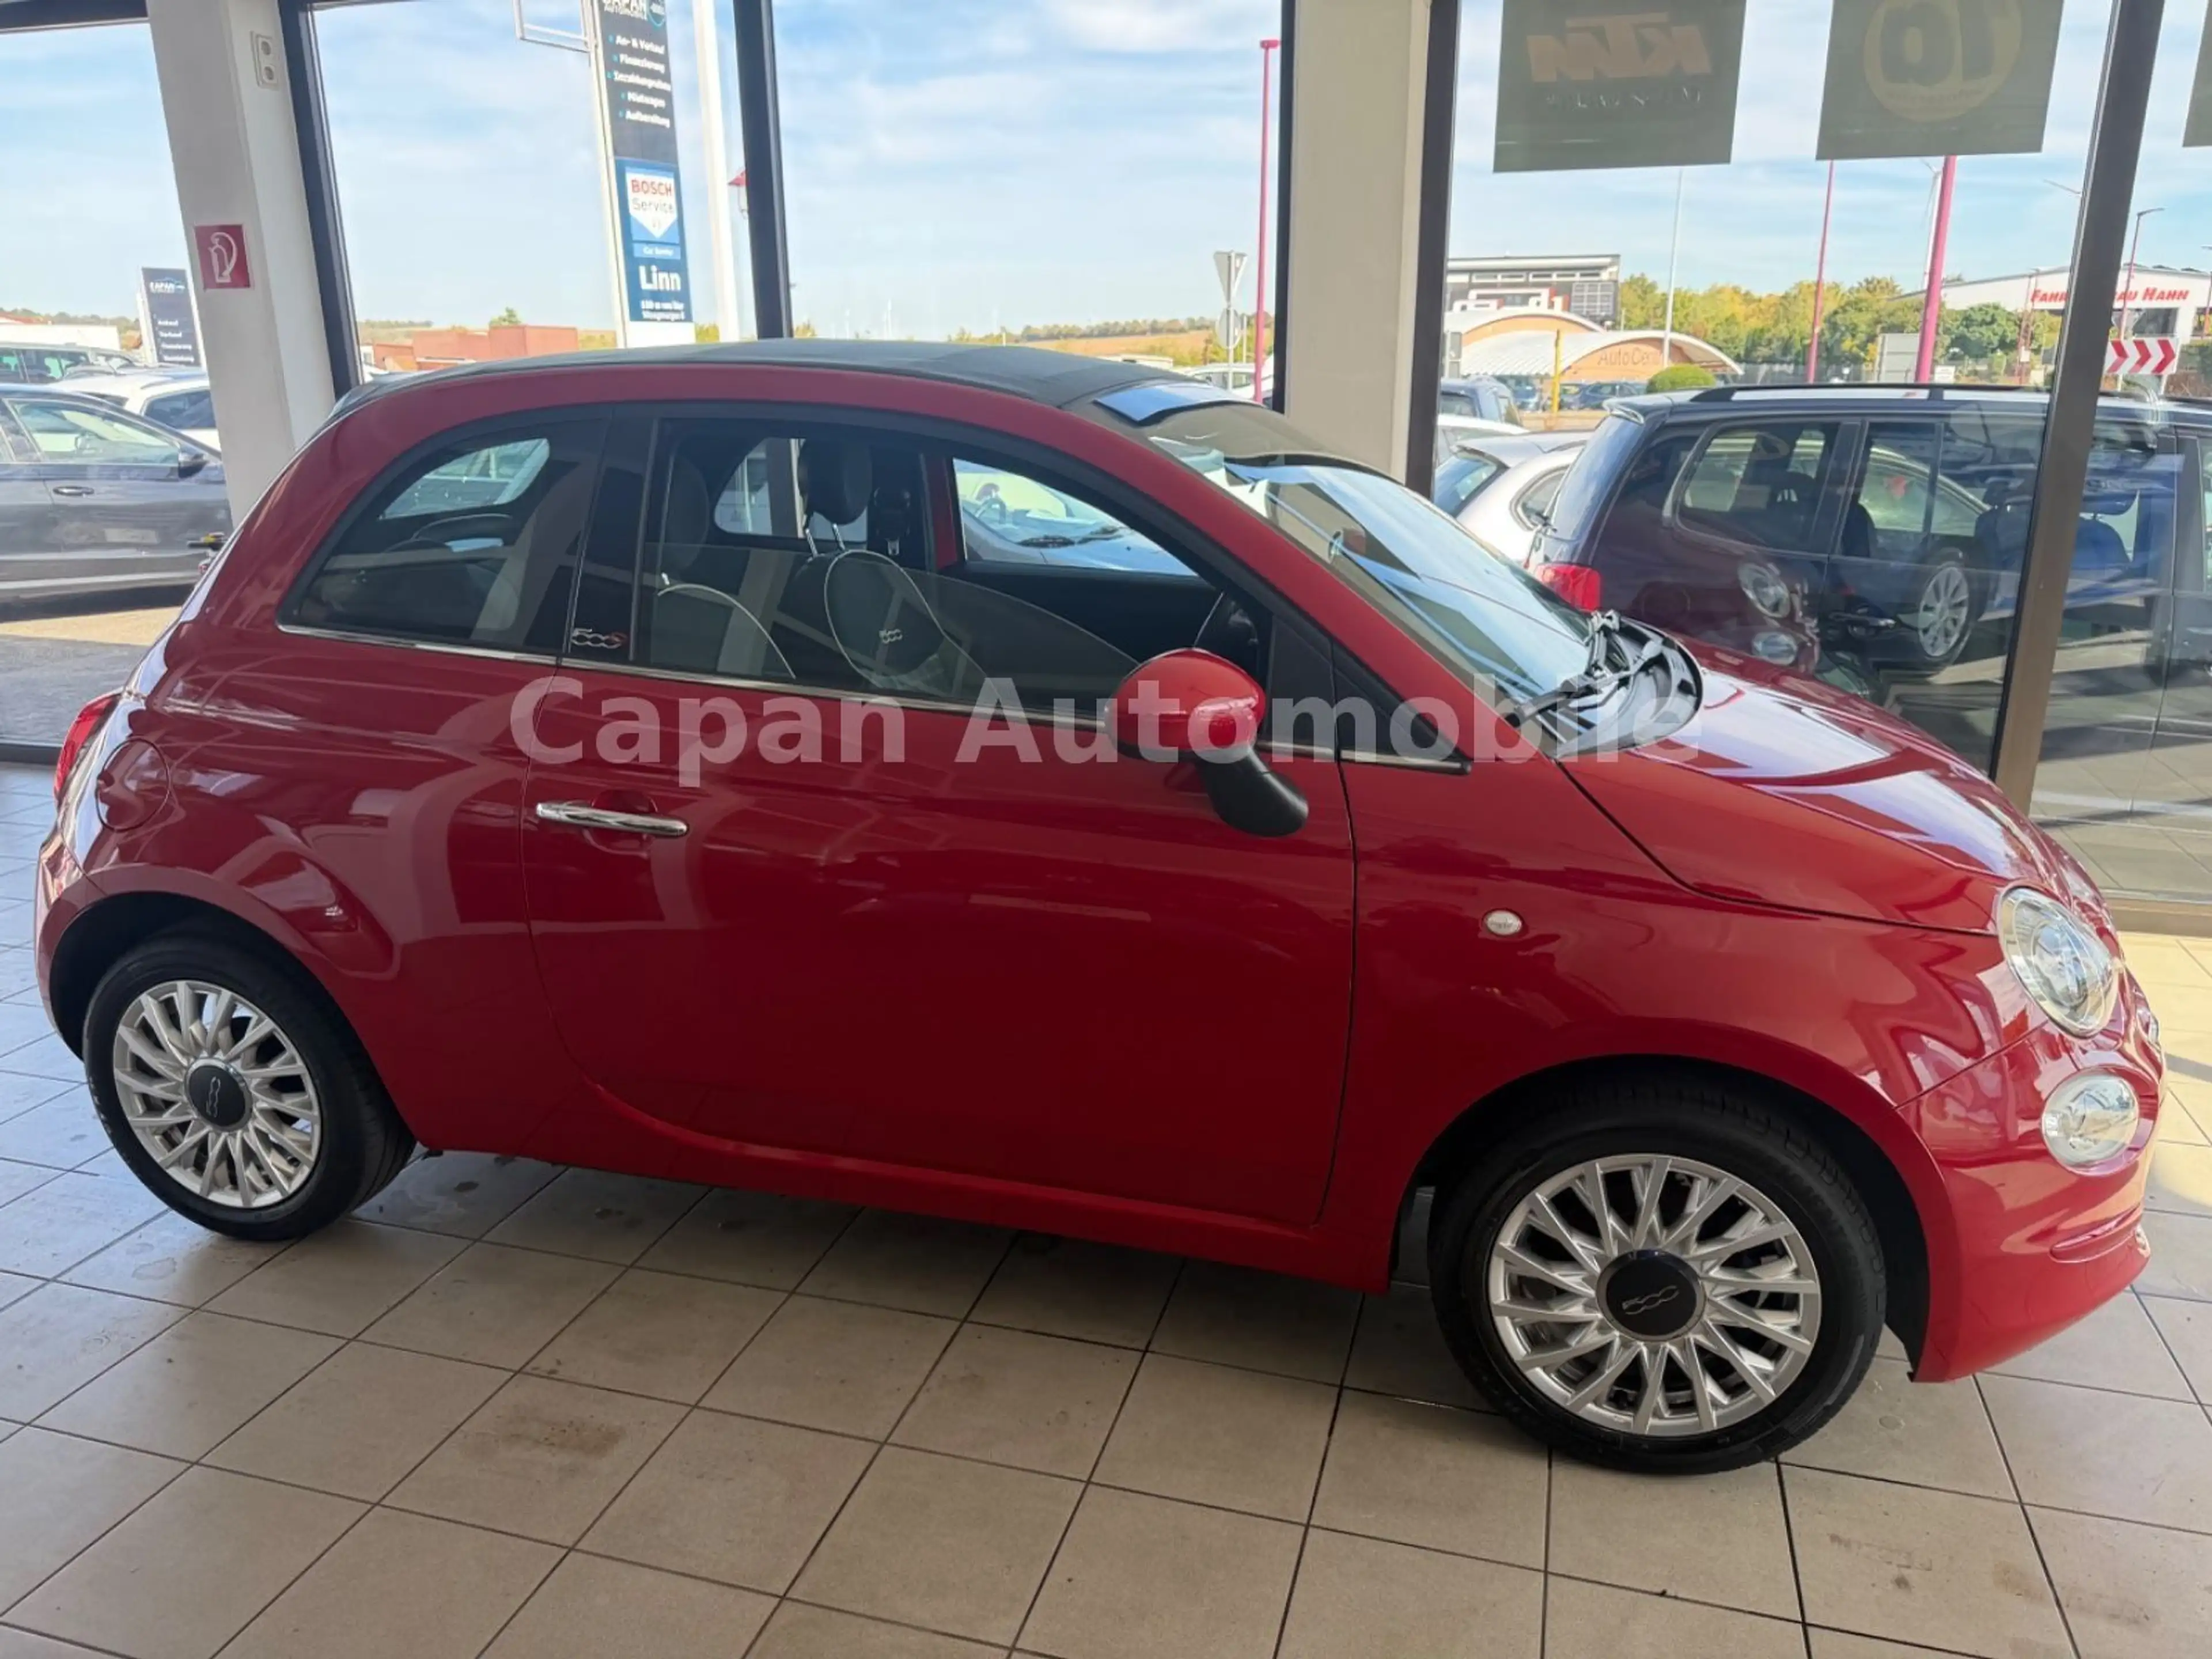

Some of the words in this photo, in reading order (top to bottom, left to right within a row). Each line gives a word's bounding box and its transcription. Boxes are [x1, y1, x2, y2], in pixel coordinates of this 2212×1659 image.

[631, 180, 672, 196] BOSCH
[632, 198, 674, 214] Service
[639, 266, 681, 291] Linn
